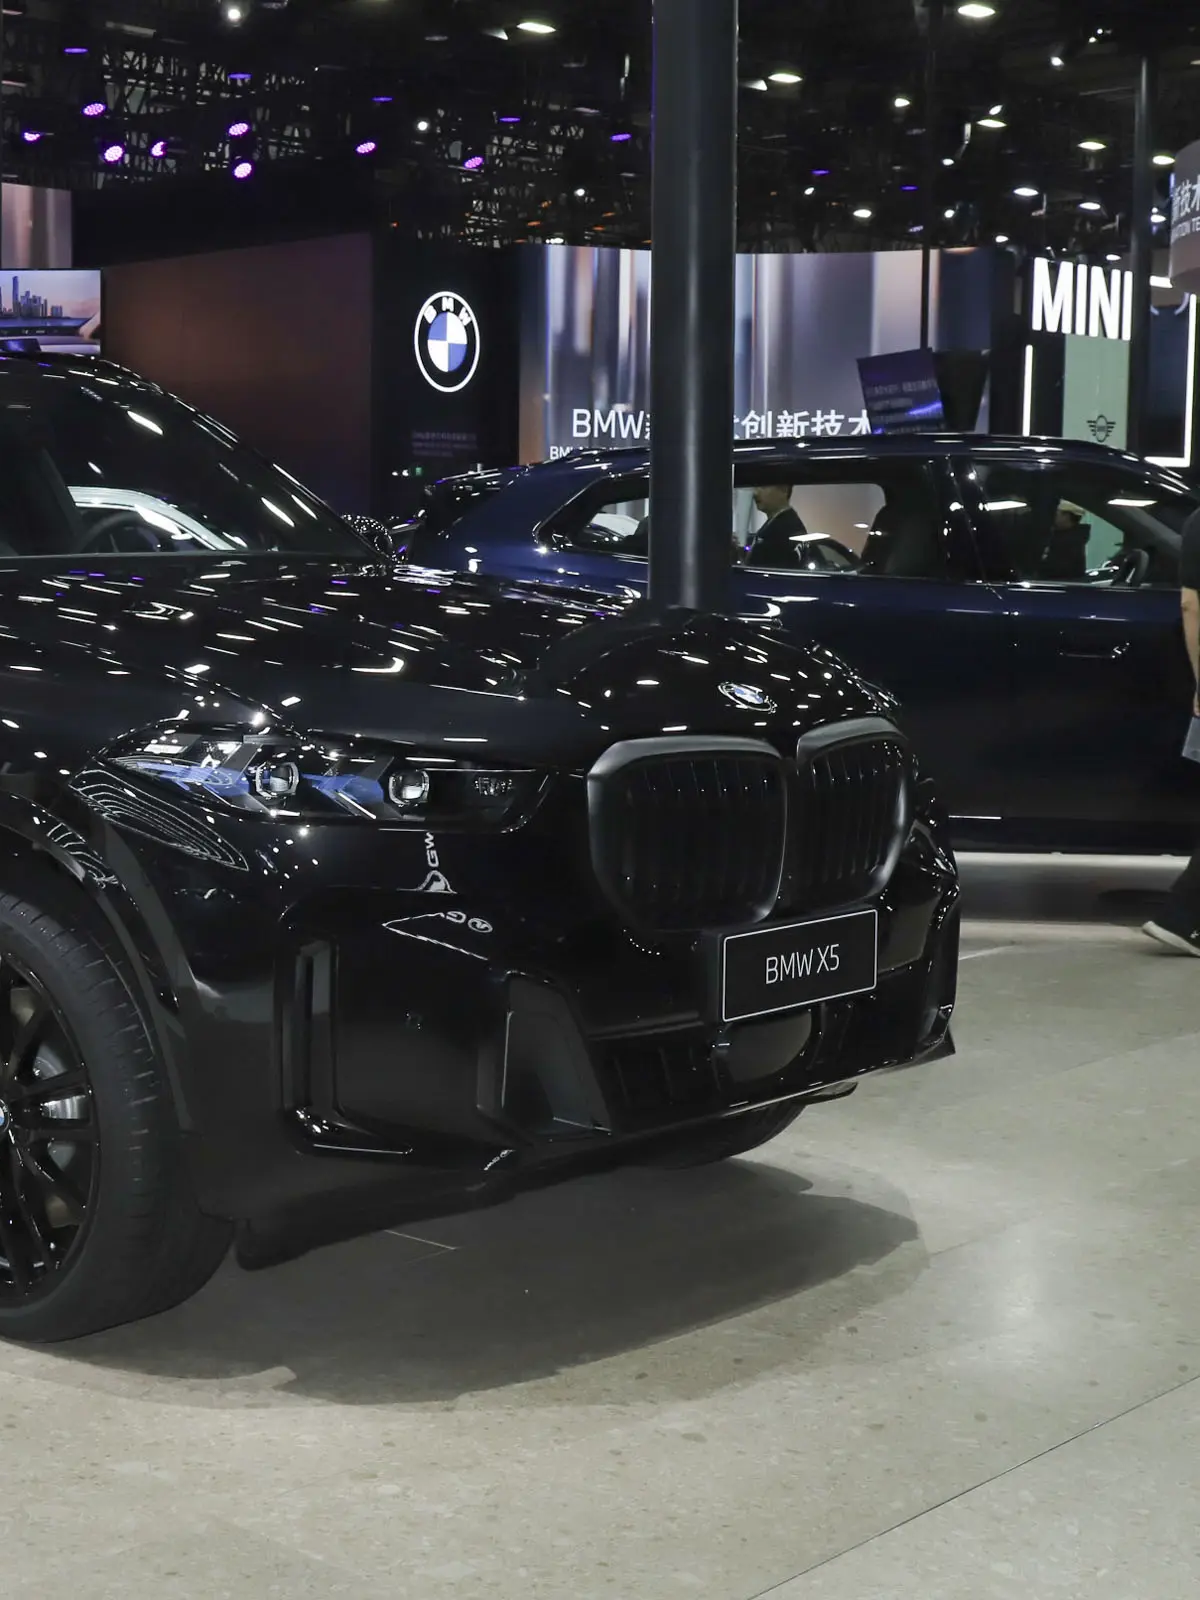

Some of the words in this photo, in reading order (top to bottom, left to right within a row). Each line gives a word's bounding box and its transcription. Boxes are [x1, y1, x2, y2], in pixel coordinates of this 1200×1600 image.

[422, 296, 473, 326] BMW
[1032, 256, 1133, 341] MINI
[766, 948, 813, 984] BMW
[816, 943, 840, 973] X5
